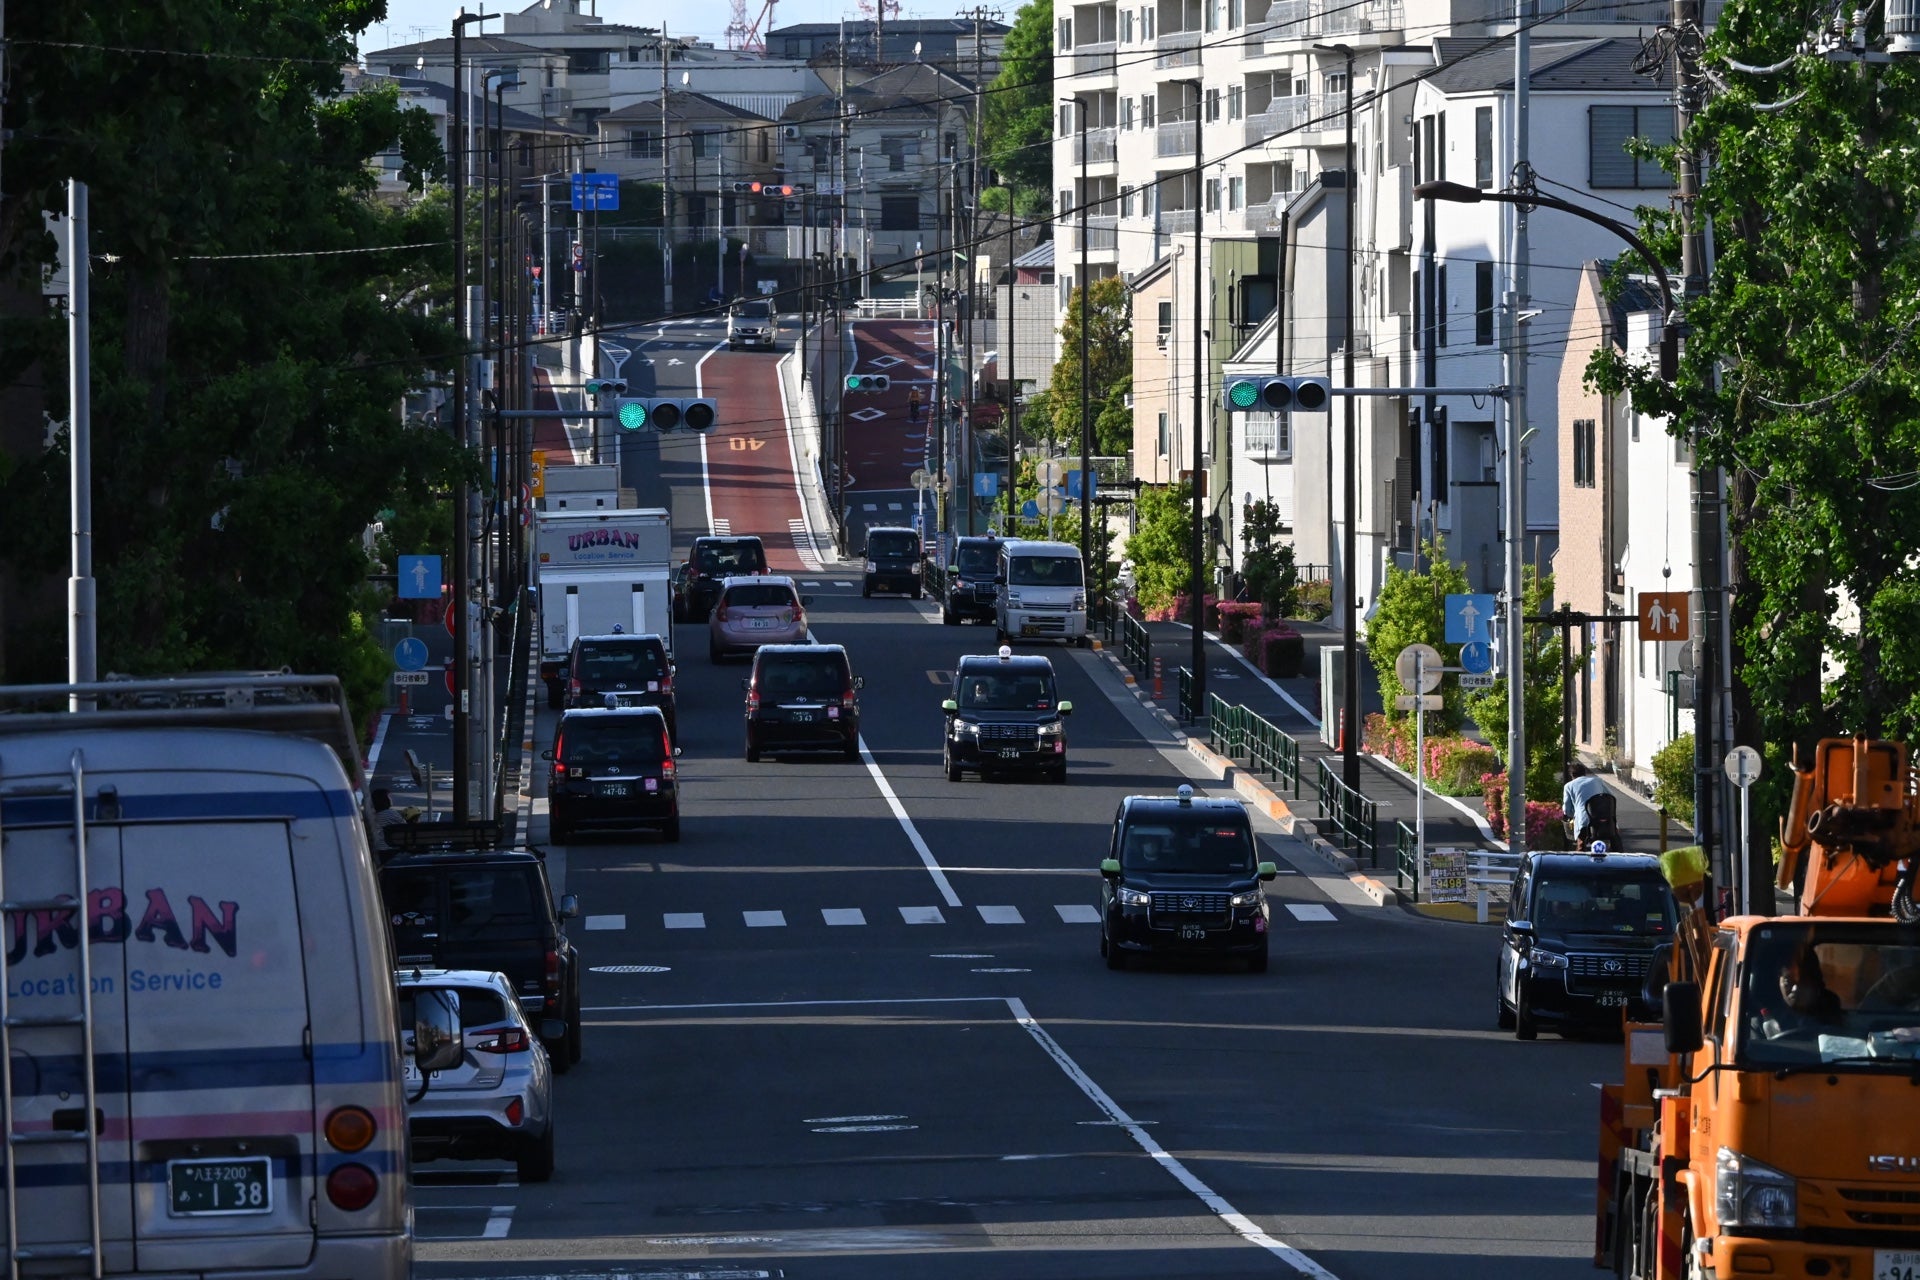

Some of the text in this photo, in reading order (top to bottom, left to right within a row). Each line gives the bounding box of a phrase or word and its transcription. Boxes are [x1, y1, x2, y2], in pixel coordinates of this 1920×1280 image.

[568, 529, 639, 551] URBAN
[608, 551, 635, 559] Service
[1462, 677, 1493, 685] 歩行者優先
[1182, 929, 1206, 939] 10-79
[8, 969, 222, 997] Locaton Service
[1869, 1155, 1920, 1172] ISU
